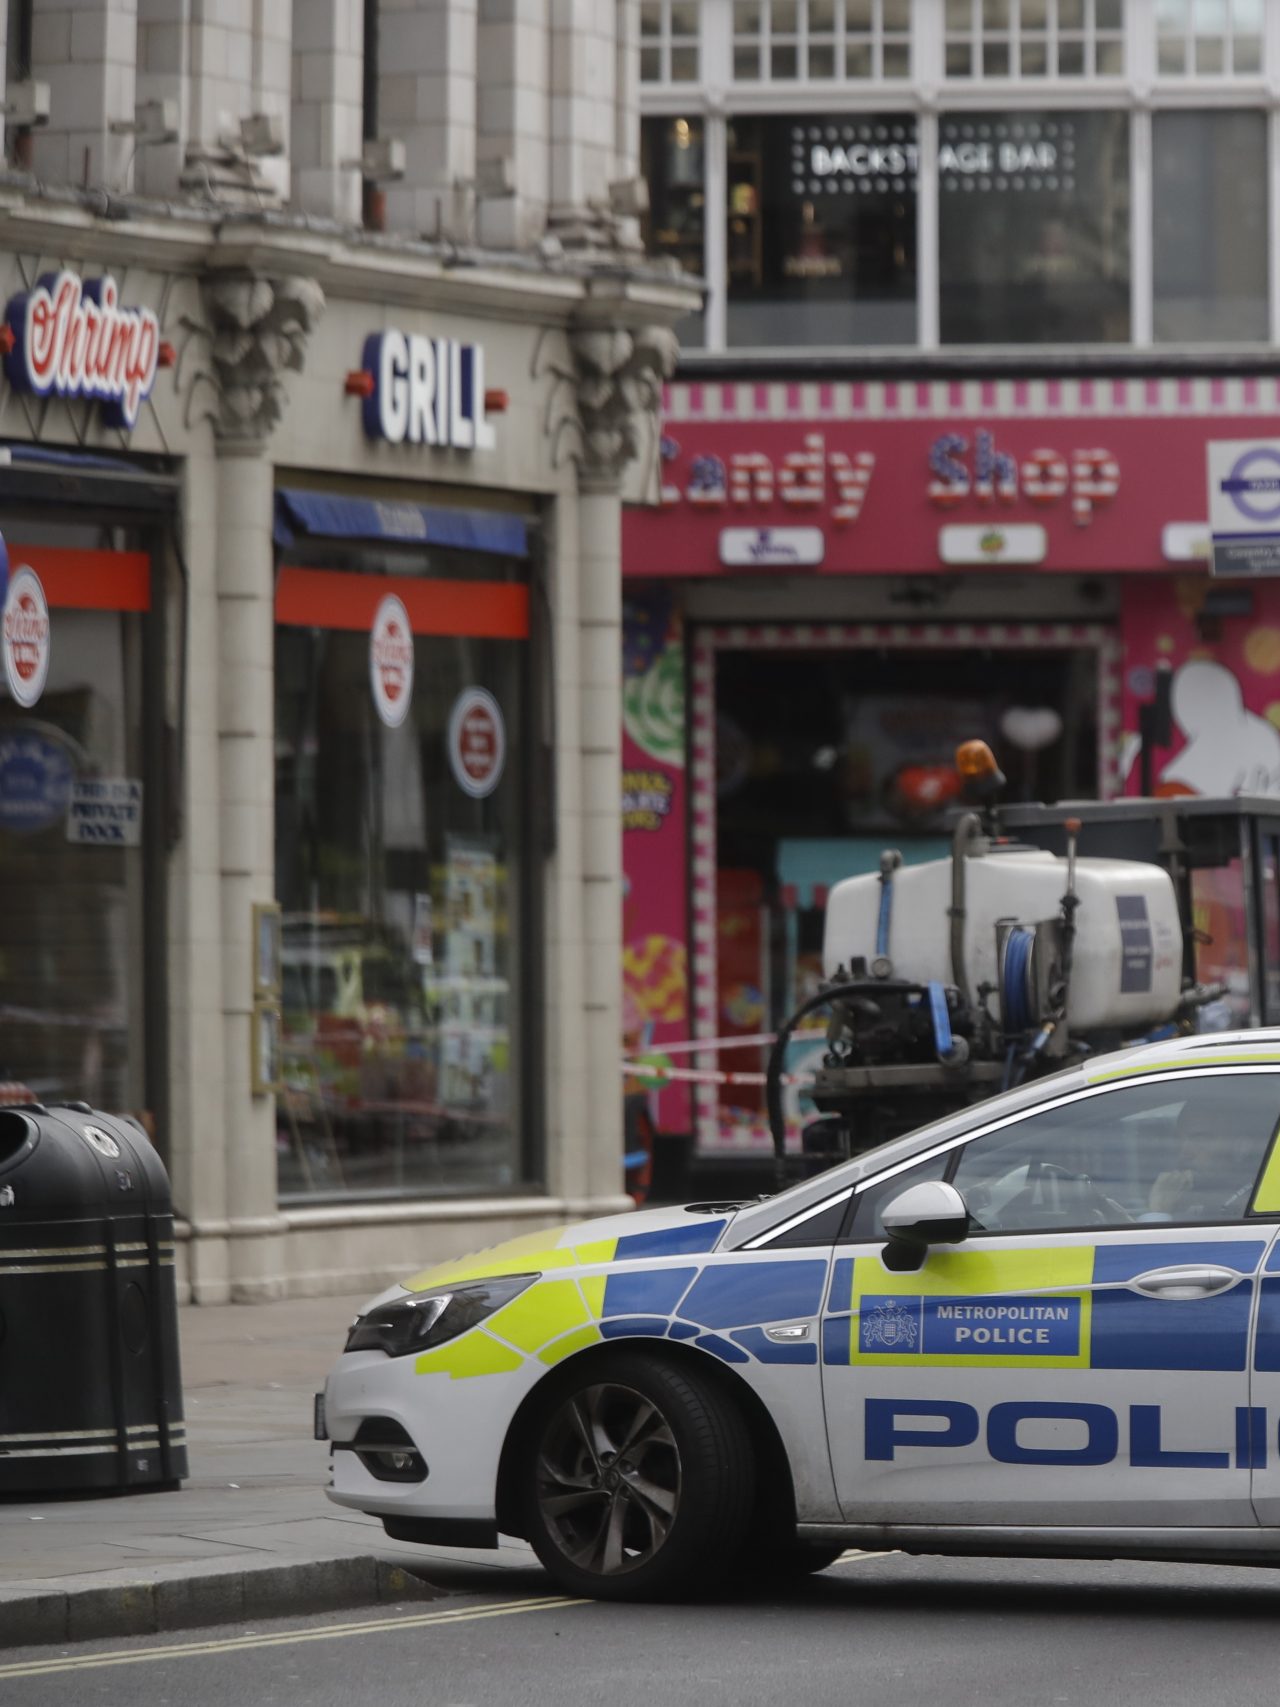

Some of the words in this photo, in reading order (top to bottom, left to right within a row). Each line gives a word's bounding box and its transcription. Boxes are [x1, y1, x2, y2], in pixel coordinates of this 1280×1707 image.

[811, 142, 993, 175] BACKSTAGE
[1001, 141, 1057, 173] BAR
[26, 271, 160, 426] Shrimp
[380, 328, 496, 450] GRILL
[927, 427, 1120, 527] Shop
[937, 1306, 1069, 1320] METROPOLITAN
[955, 1327, 1050, 1344] POLICE
